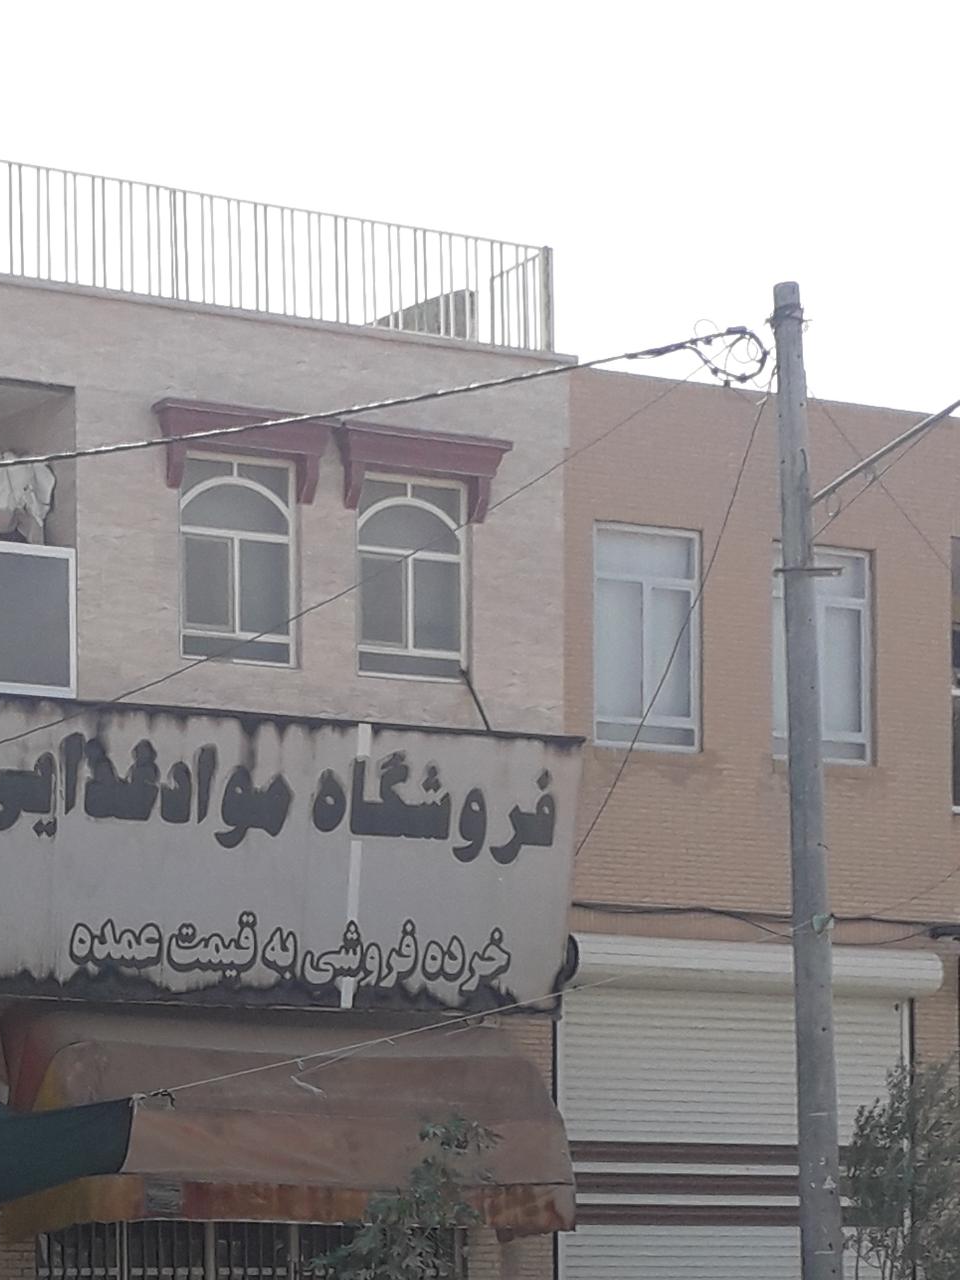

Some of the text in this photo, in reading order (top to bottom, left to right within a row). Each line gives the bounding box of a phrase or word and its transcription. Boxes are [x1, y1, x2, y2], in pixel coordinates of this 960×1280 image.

[158, 743, 296, 849] مواد
[311, 750, 557, 865] فروشگاه
[67, 918, 164, 970] عمده
[165, 910, 259, 981] قیمت
[260, 925, 299, 981] به
[421, 926, 512, 994] خرده
